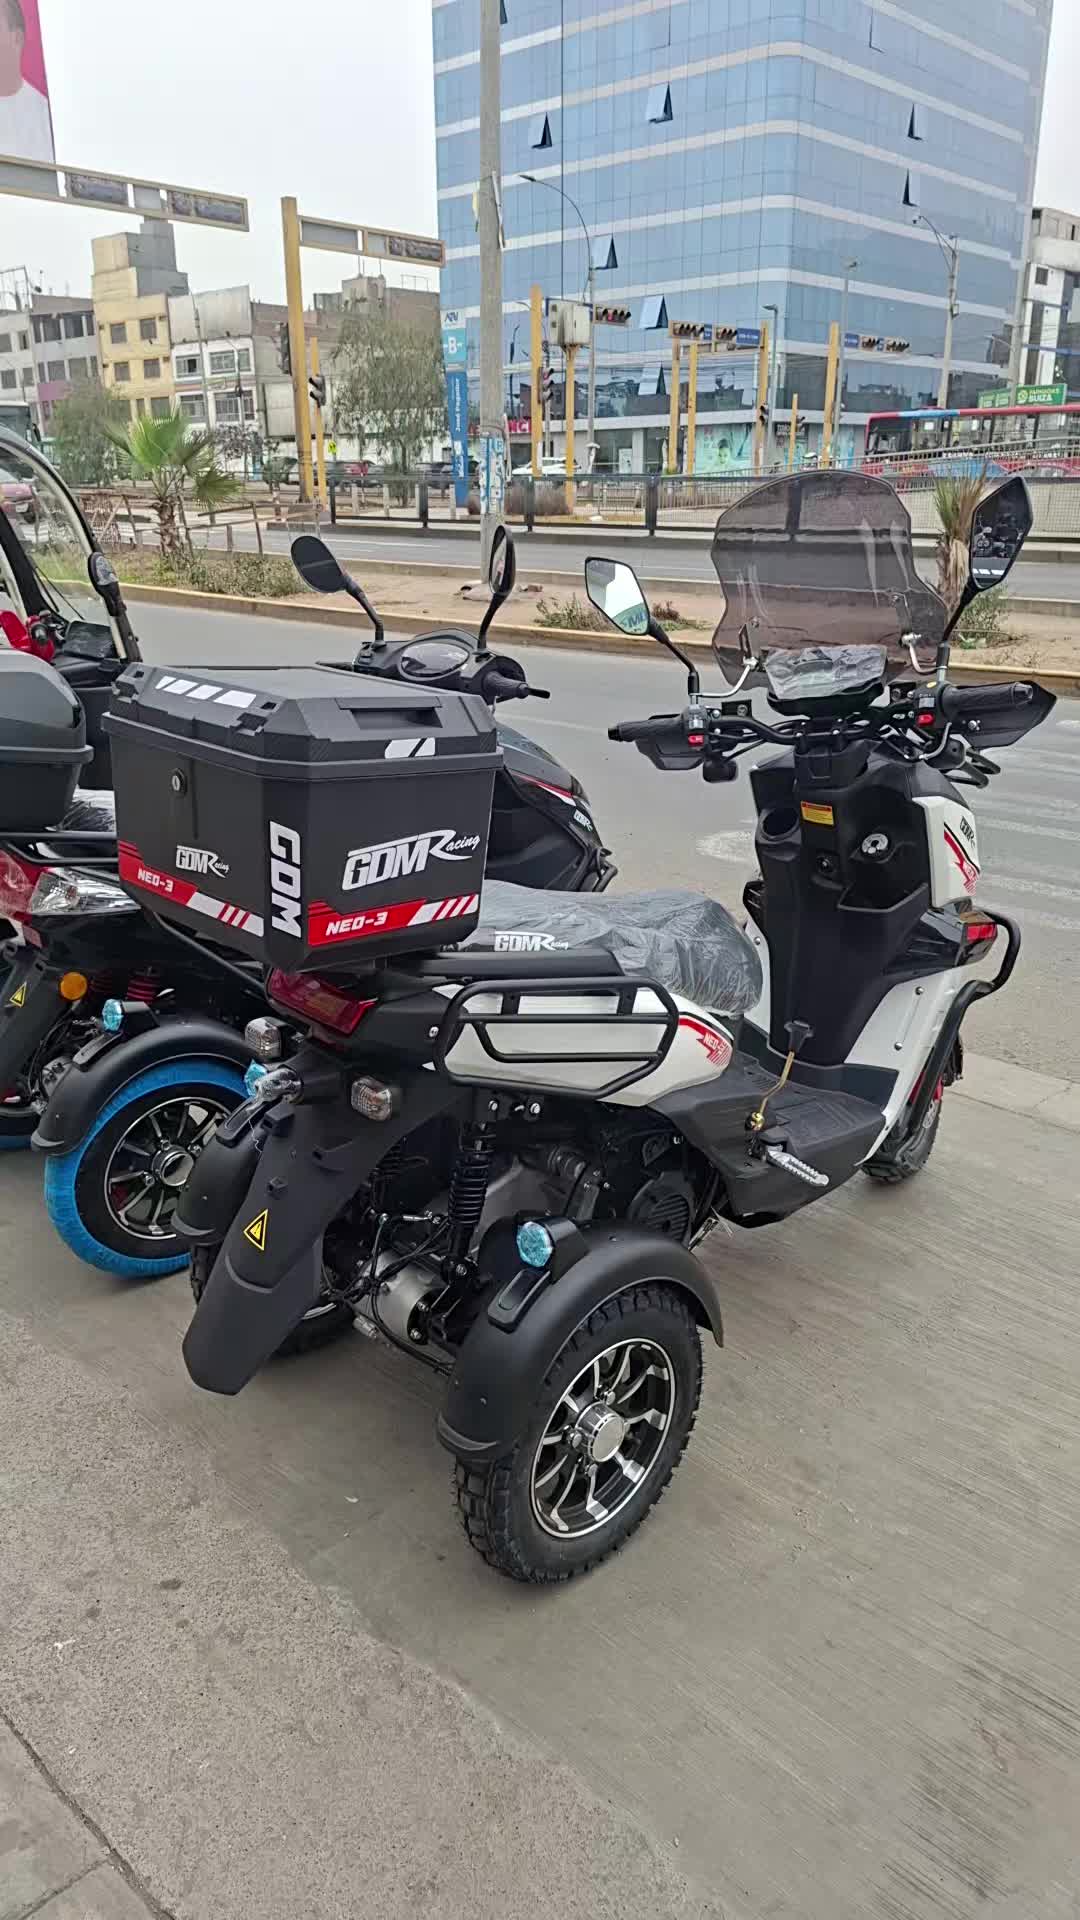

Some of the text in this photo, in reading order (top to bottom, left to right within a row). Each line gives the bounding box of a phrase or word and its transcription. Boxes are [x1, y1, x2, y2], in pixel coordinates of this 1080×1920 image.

[137, 868, 174, 893] NEO-3
[269, 820, 302, 938] GDM
[325, 911, 388, 936] NEO-3
